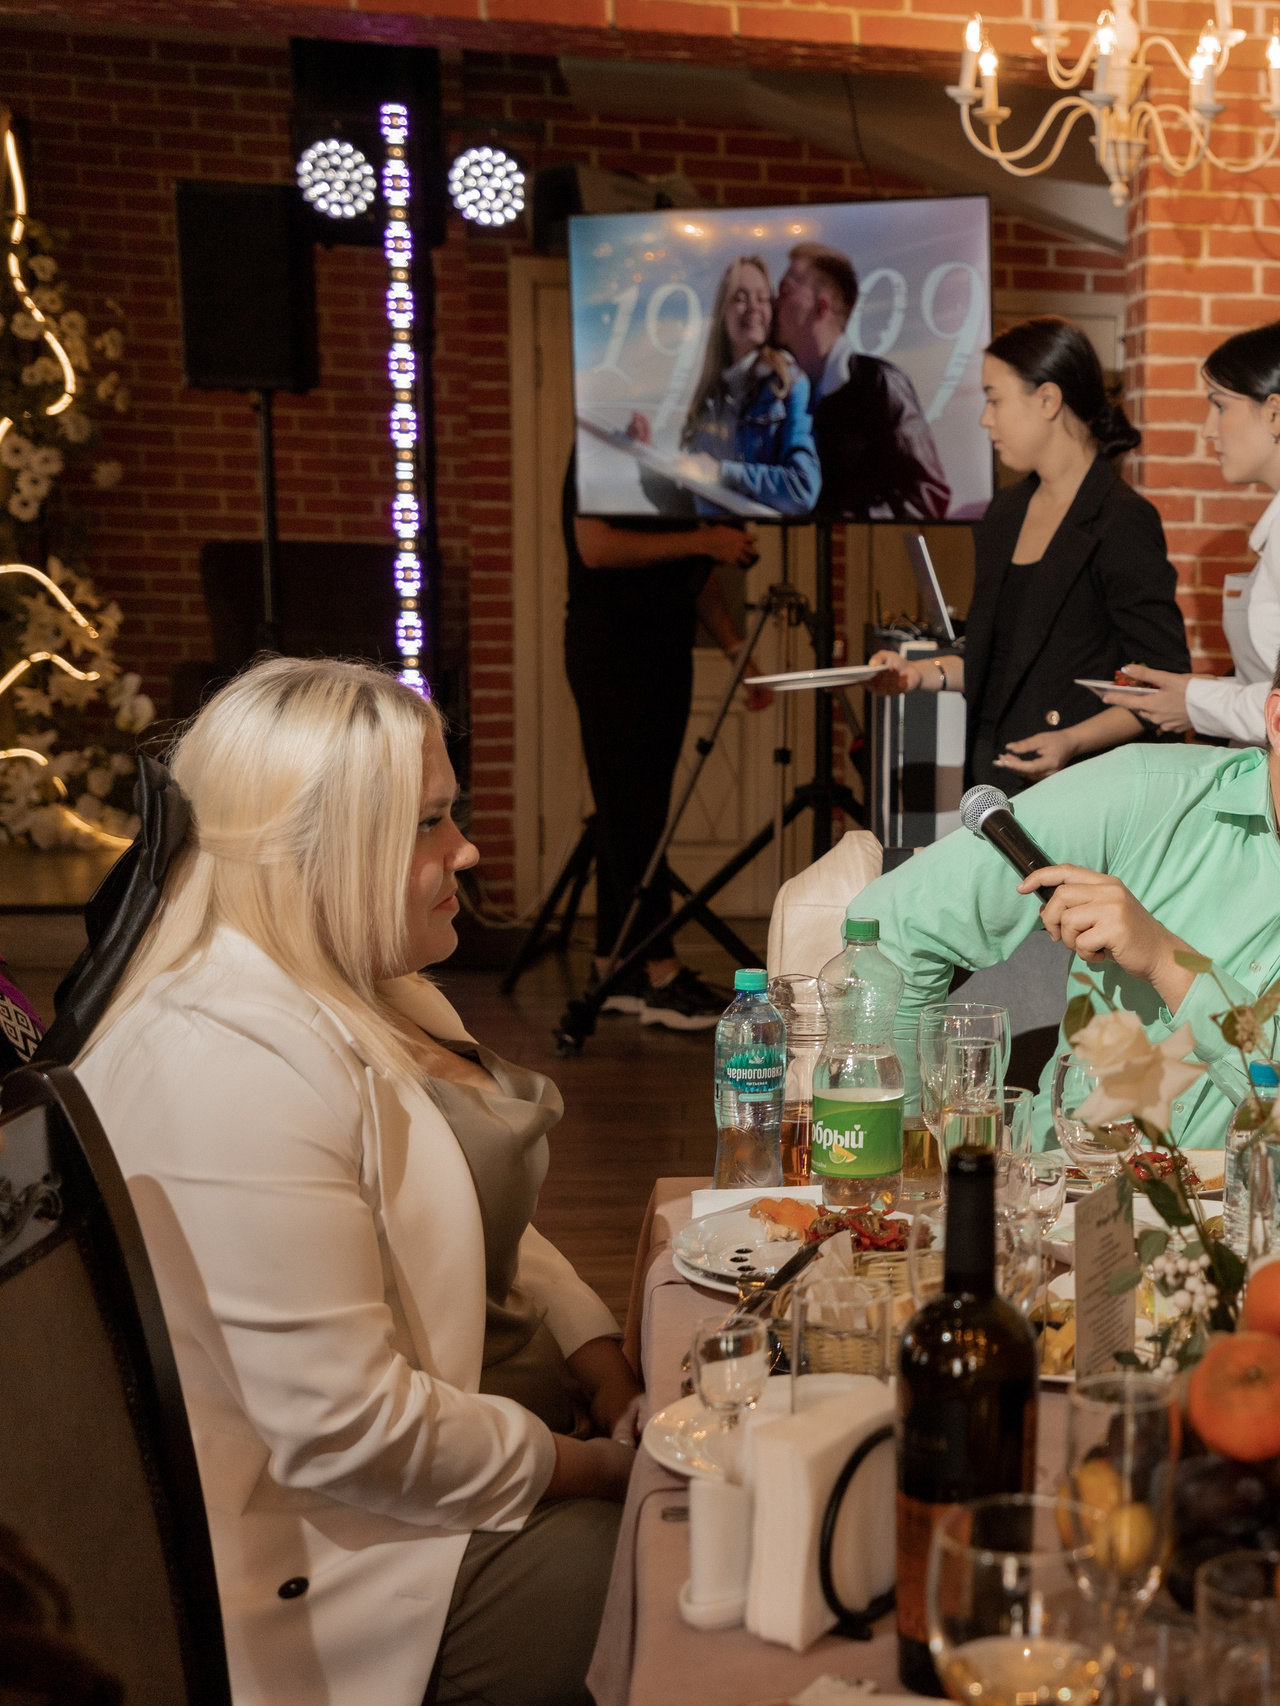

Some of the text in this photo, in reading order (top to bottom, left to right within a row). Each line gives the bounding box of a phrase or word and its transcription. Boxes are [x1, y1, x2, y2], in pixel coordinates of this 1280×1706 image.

[592, 263, 987, 432] 19 09
[812, 1120, 864, 1150] обрый
